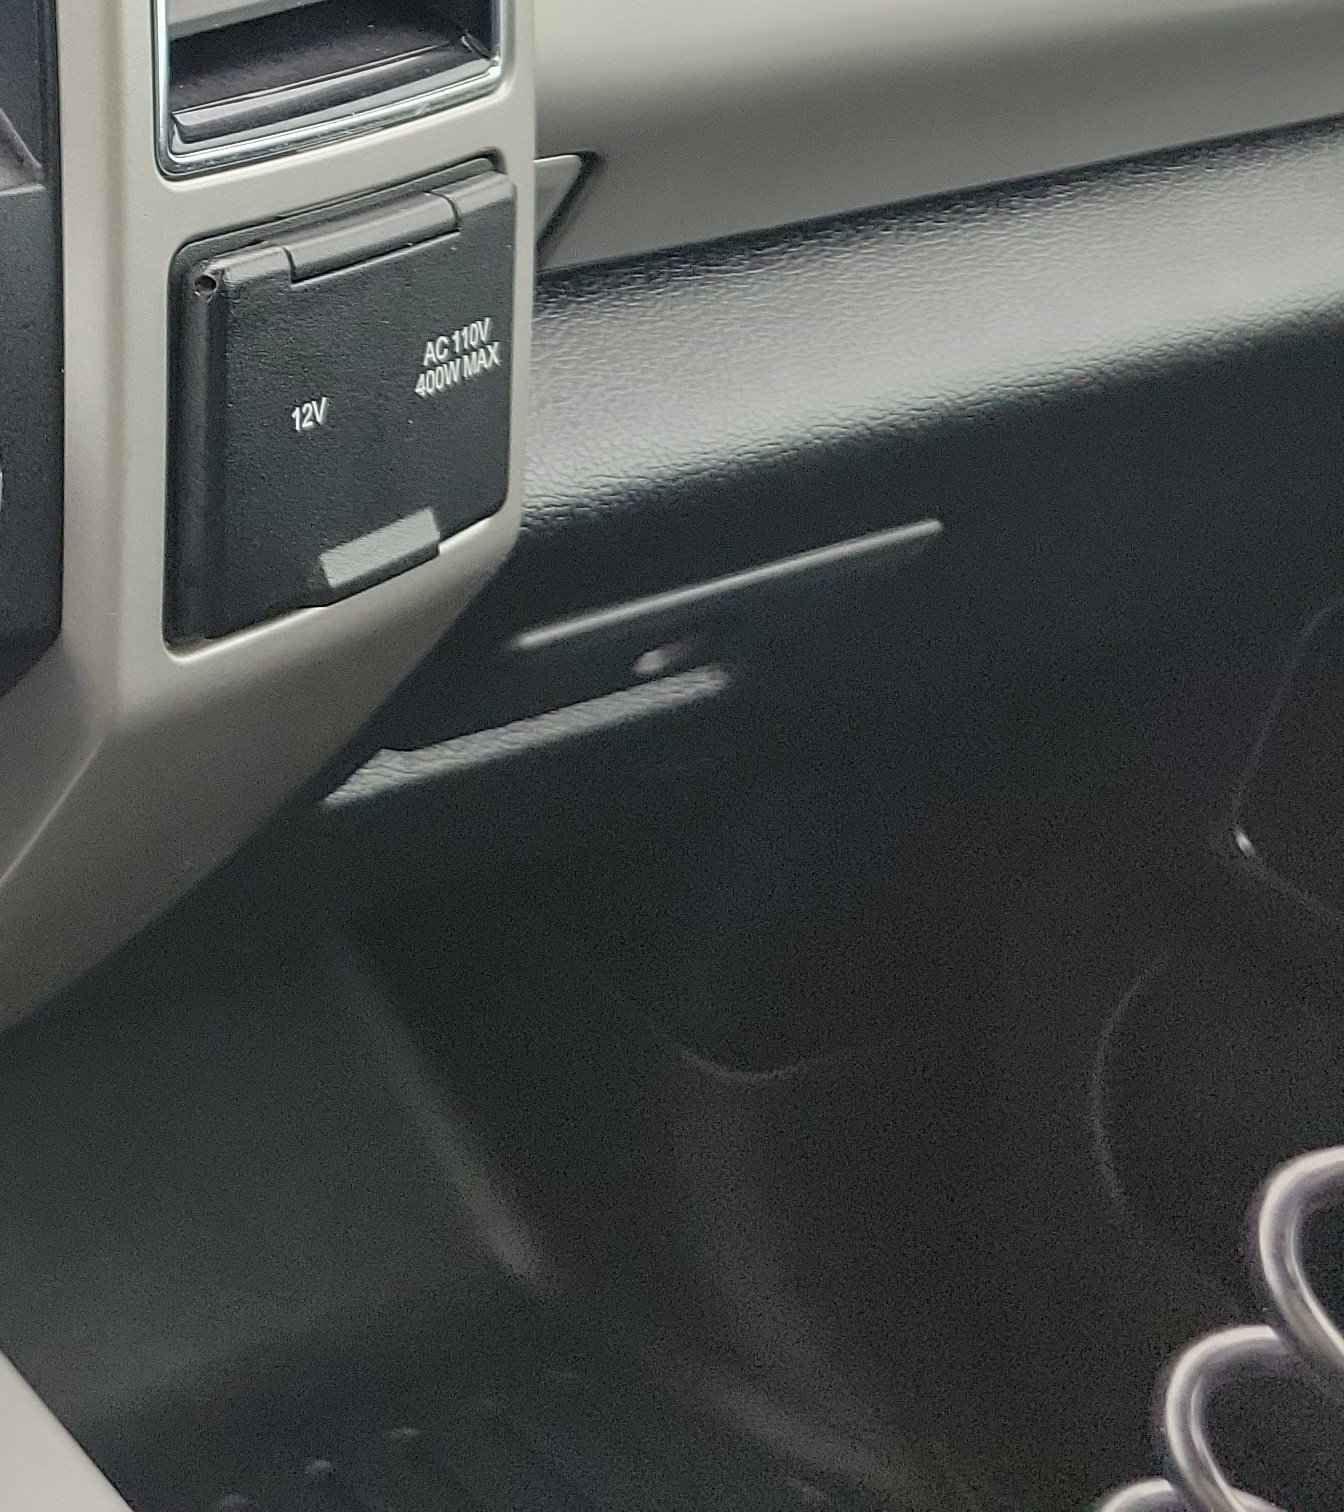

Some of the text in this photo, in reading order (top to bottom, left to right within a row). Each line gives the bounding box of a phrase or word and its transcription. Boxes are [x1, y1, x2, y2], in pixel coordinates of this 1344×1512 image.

[423, 317, 492, 366] AC 110V
[414, 341, 500, 398] 400W MAX
[291, 397, 329, 431] 12V
